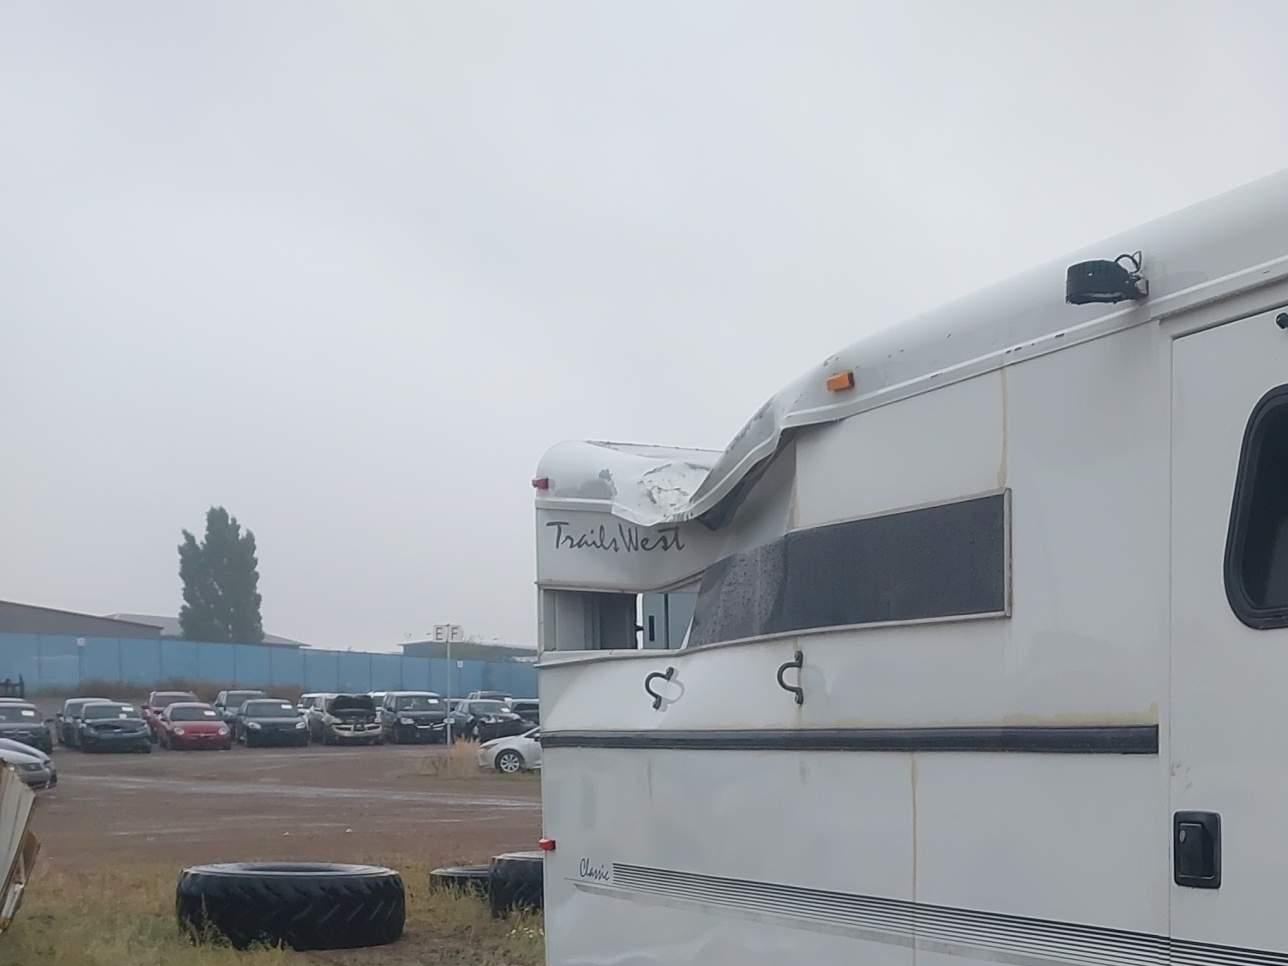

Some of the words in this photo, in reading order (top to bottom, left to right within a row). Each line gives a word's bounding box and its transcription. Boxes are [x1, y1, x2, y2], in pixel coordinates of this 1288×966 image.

[435, 626, 444, 641] E
[450, 626, 459, 641] F
[579, 857, 610, 881] Classic
